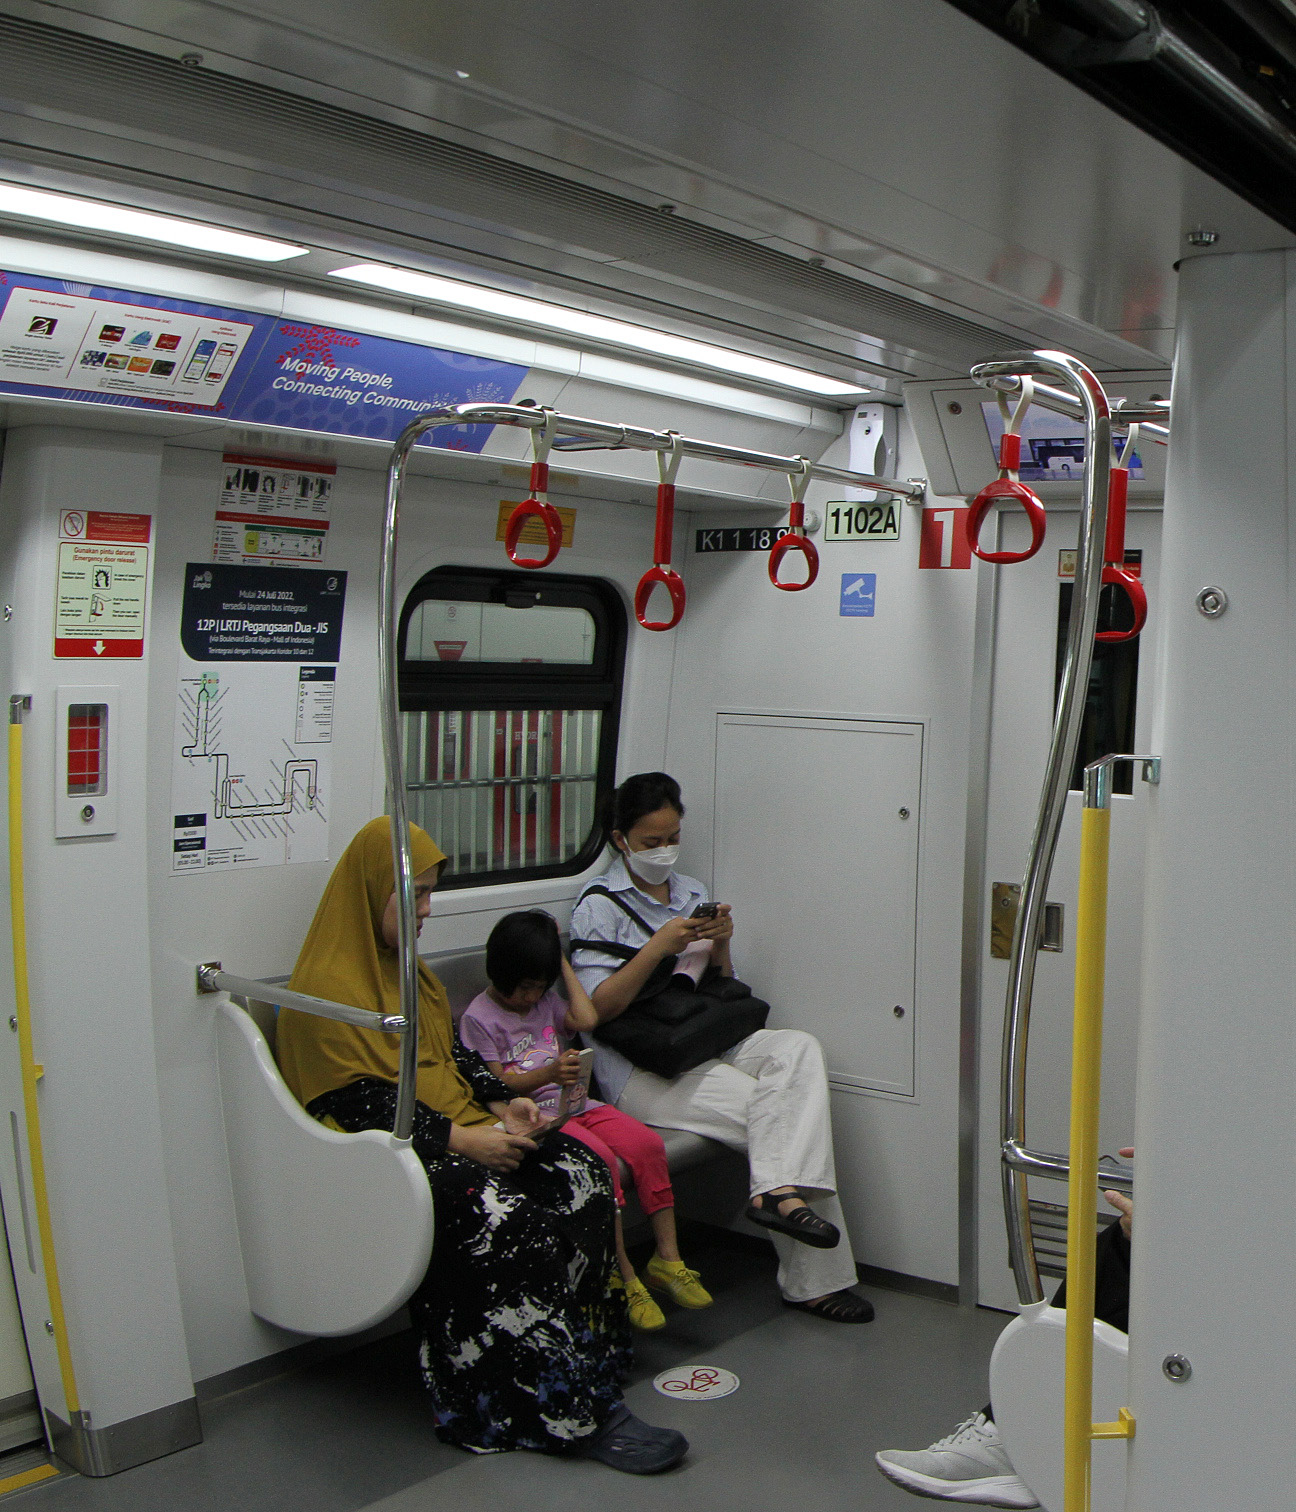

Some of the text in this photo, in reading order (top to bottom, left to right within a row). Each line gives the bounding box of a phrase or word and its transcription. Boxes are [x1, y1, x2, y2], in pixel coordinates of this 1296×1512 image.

[280, 357, 394, 390] Moving People,
[272, 376, 363, 405] Connecting
[830, 505, 897, 535] 1102A
[933, 510, 955, 568] 1
[72, 554, 102, 562] (Emergency
[238, 590, 256, 598] Mulai
[256, 590, 266, 598] 24
[266, 590, 278, 600] Juli
[222, 602, 308, 614] tersedia layanan bus integrasi
[196, 618, 216, 630] 12P
[220, 620, 242, 632] LRTJ
[244, 622, 294, 634] Pegangsaan
[294, 622, 310, 632] Dua
[316, 622, 328, 634] JIS
